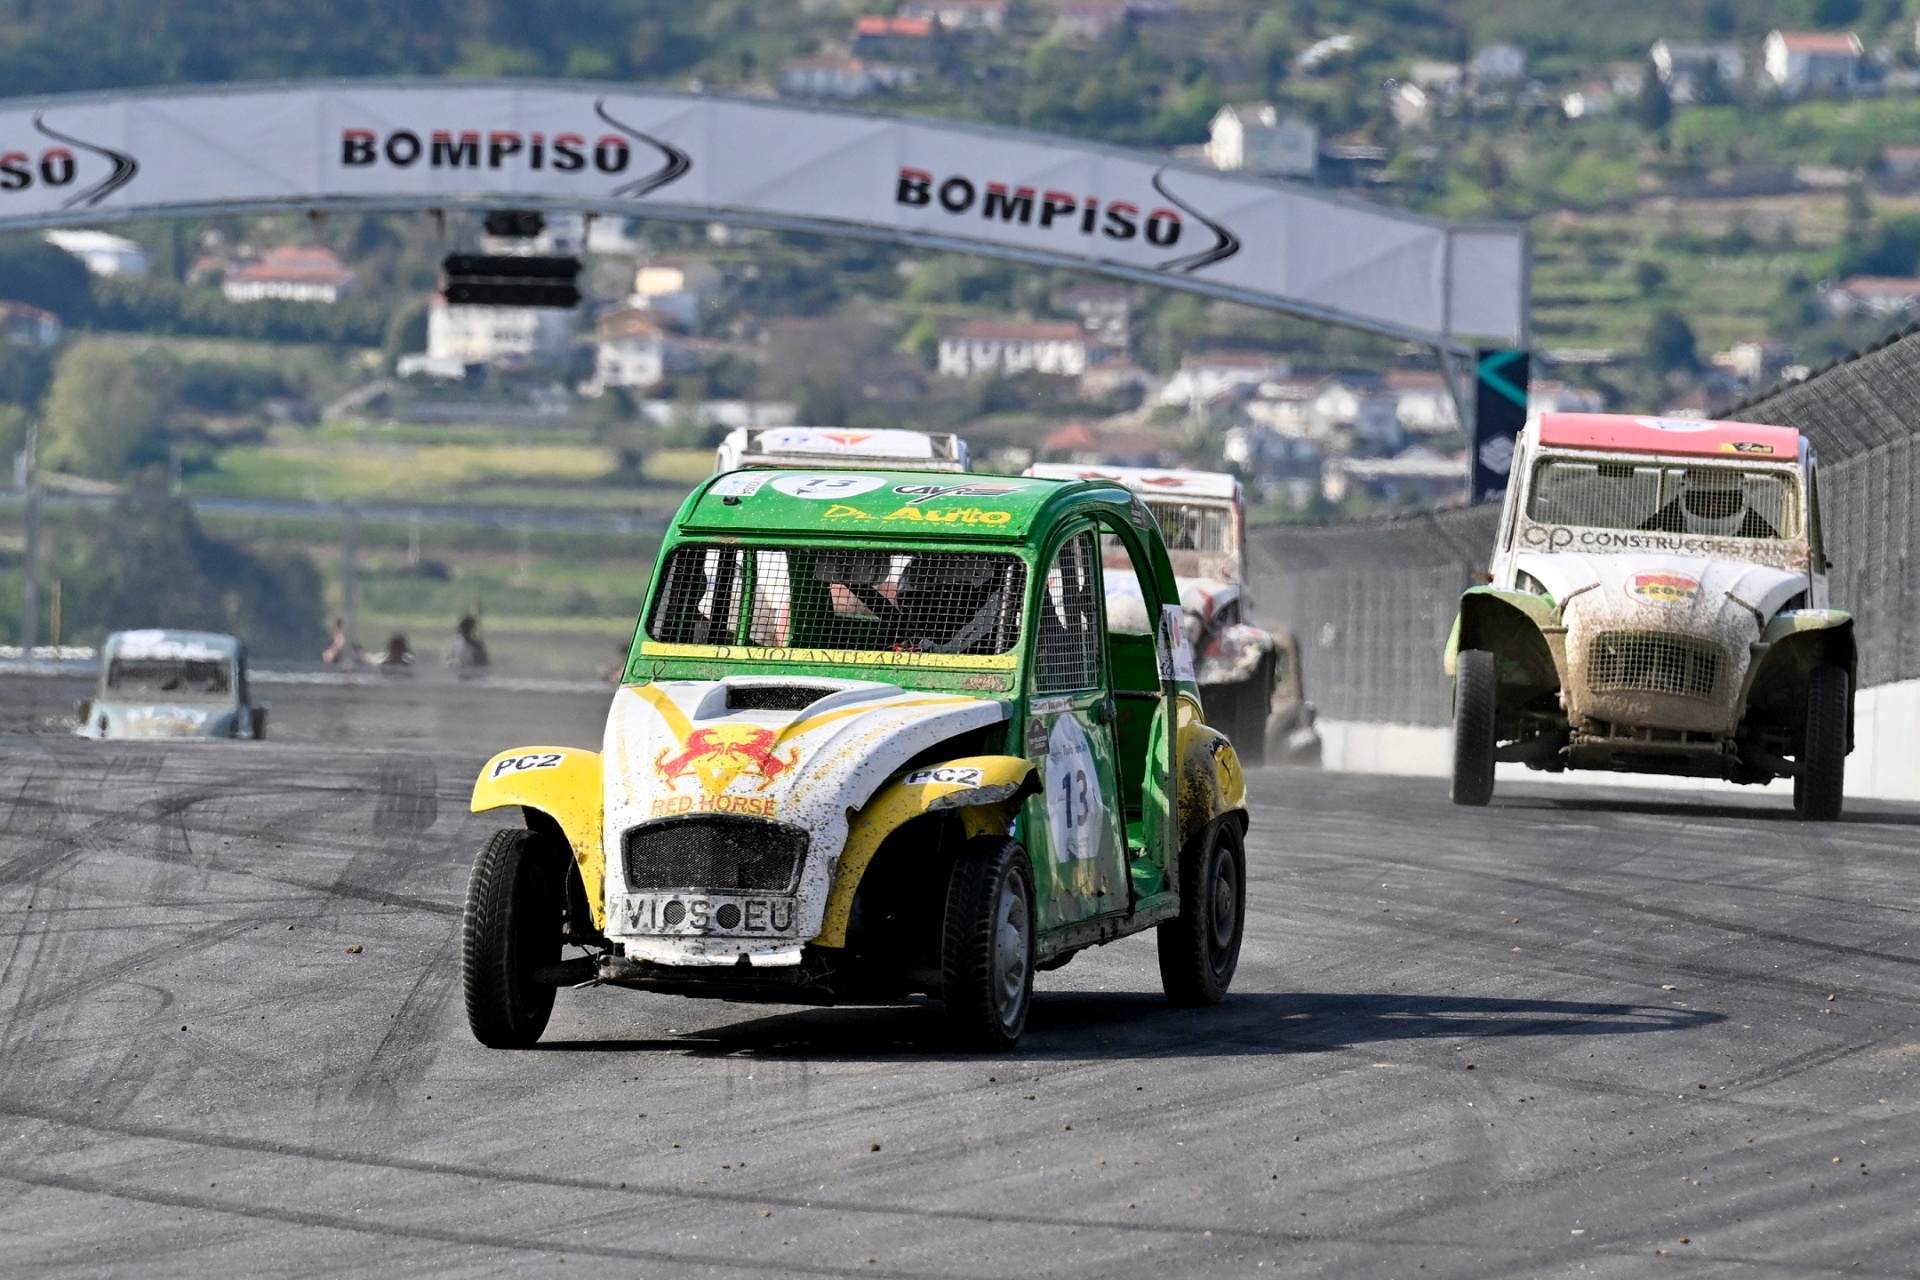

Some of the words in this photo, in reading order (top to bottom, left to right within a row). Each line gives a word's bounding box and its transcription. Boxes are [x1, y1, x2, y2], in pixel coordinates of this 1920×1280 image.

[341, 127, 631, 173] BOMPISO
[897, 168, 1182, 247] BOMPISO
[884, 507, 1012, 524] Auto
[493, 754, 562, 778] PC2
[908, 768, 979, 786] PC2
[650, 796, 693, 815] RED
[698, 794, 777, 818] HORSE
[1061, 769, 1089, 829] 13
